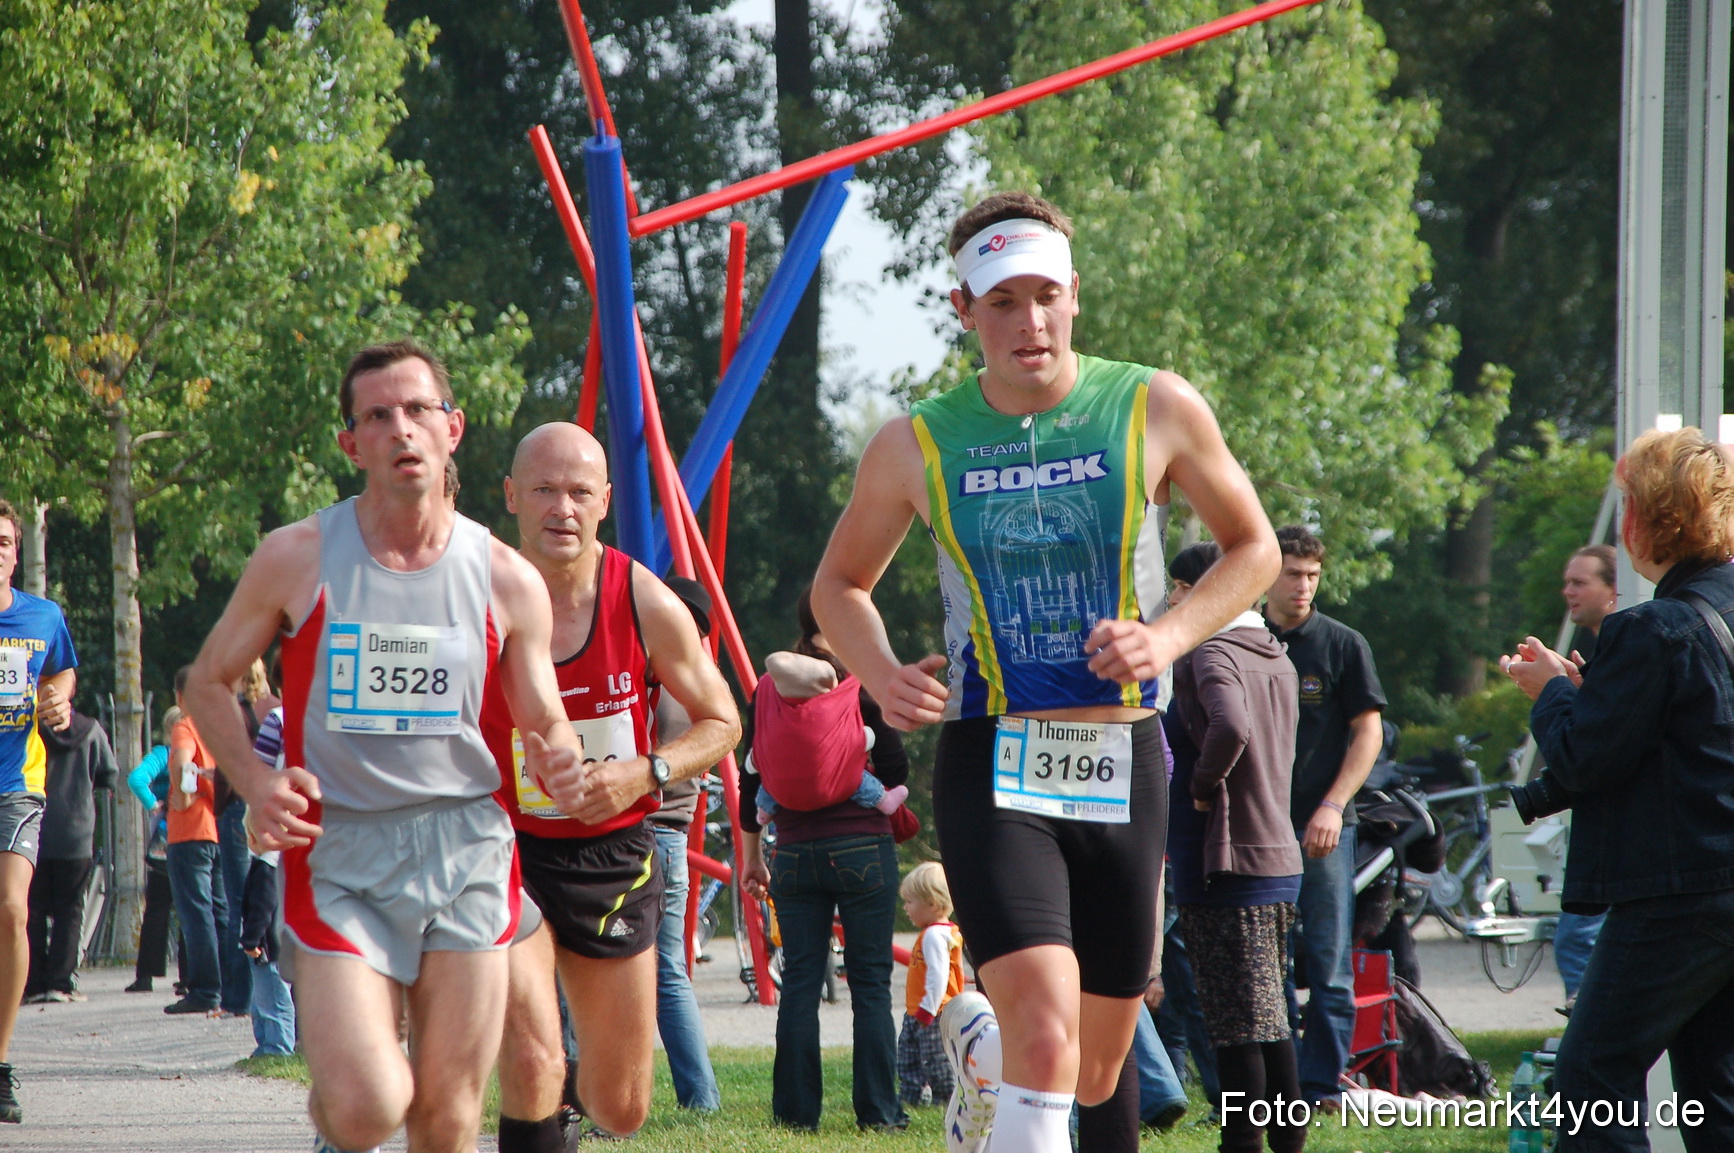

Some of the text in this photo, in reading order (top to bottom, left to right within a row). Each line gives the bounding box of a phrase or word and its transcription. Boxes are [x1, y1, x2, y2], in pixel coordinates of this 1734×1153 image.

[966, 441, 1029, 459] TEAM
[962, 451, 1110, 495] BOCK
[368, 633, 429, 654] Damian
[337, 663, 345, 677] A
[369, 665, 449, 695] 3528
[607, 671, 632, 696] LG
[1036, 719, 1098, 742] Thomas
[1003, 746, 1012, 761] A
[1034, 752, 1115, 782] 3196
[1077, 803, 1127, 814] PFLEIDERER
